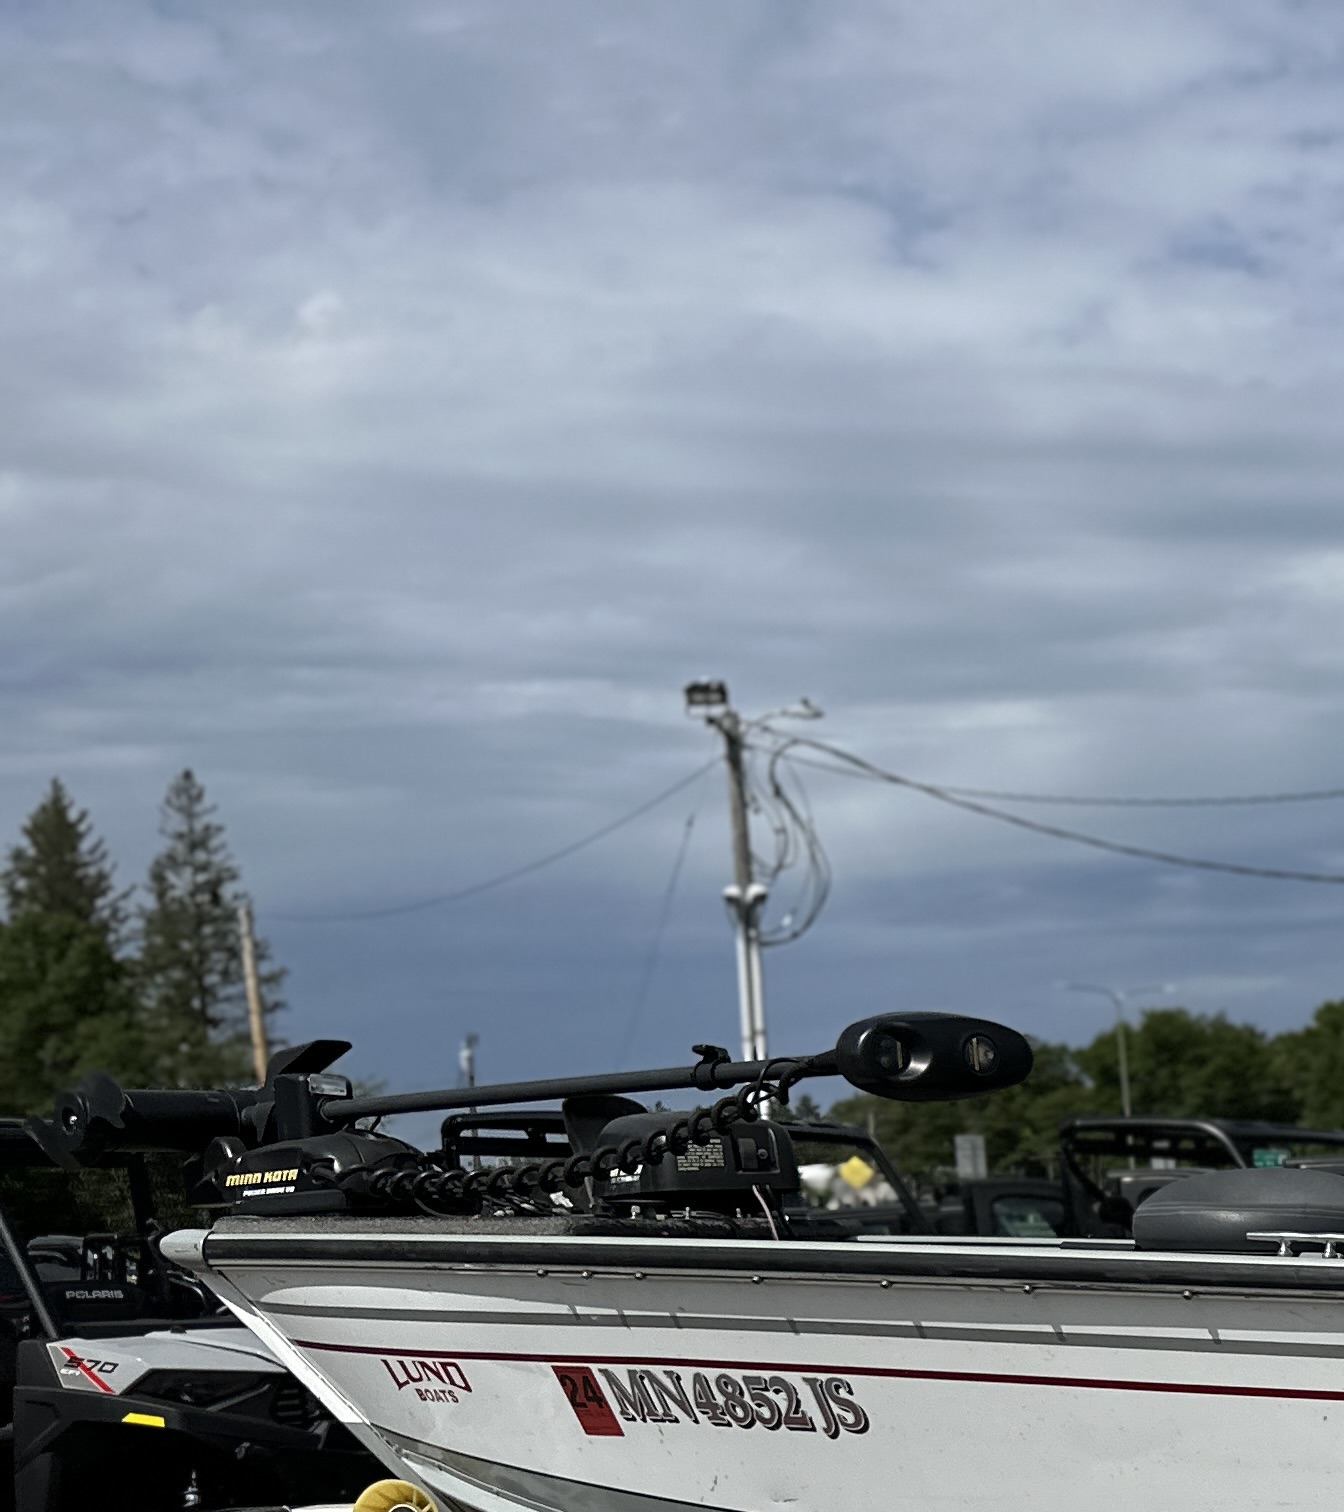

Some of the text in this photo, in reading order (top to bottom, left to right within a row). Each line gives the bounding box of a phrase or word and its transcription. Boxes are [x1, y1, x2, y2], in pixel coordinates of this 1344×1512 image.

[263, 1169, 299, 1183] KOTA
[65, 1290, 124, 1299] POLARIS
[64, 1355, 119, 1374] 570
[381, 1359, 473, 1393] LUND
[415, 1388, 460, 1404] BOATS
[559, 1374, 607, 1410] 24
